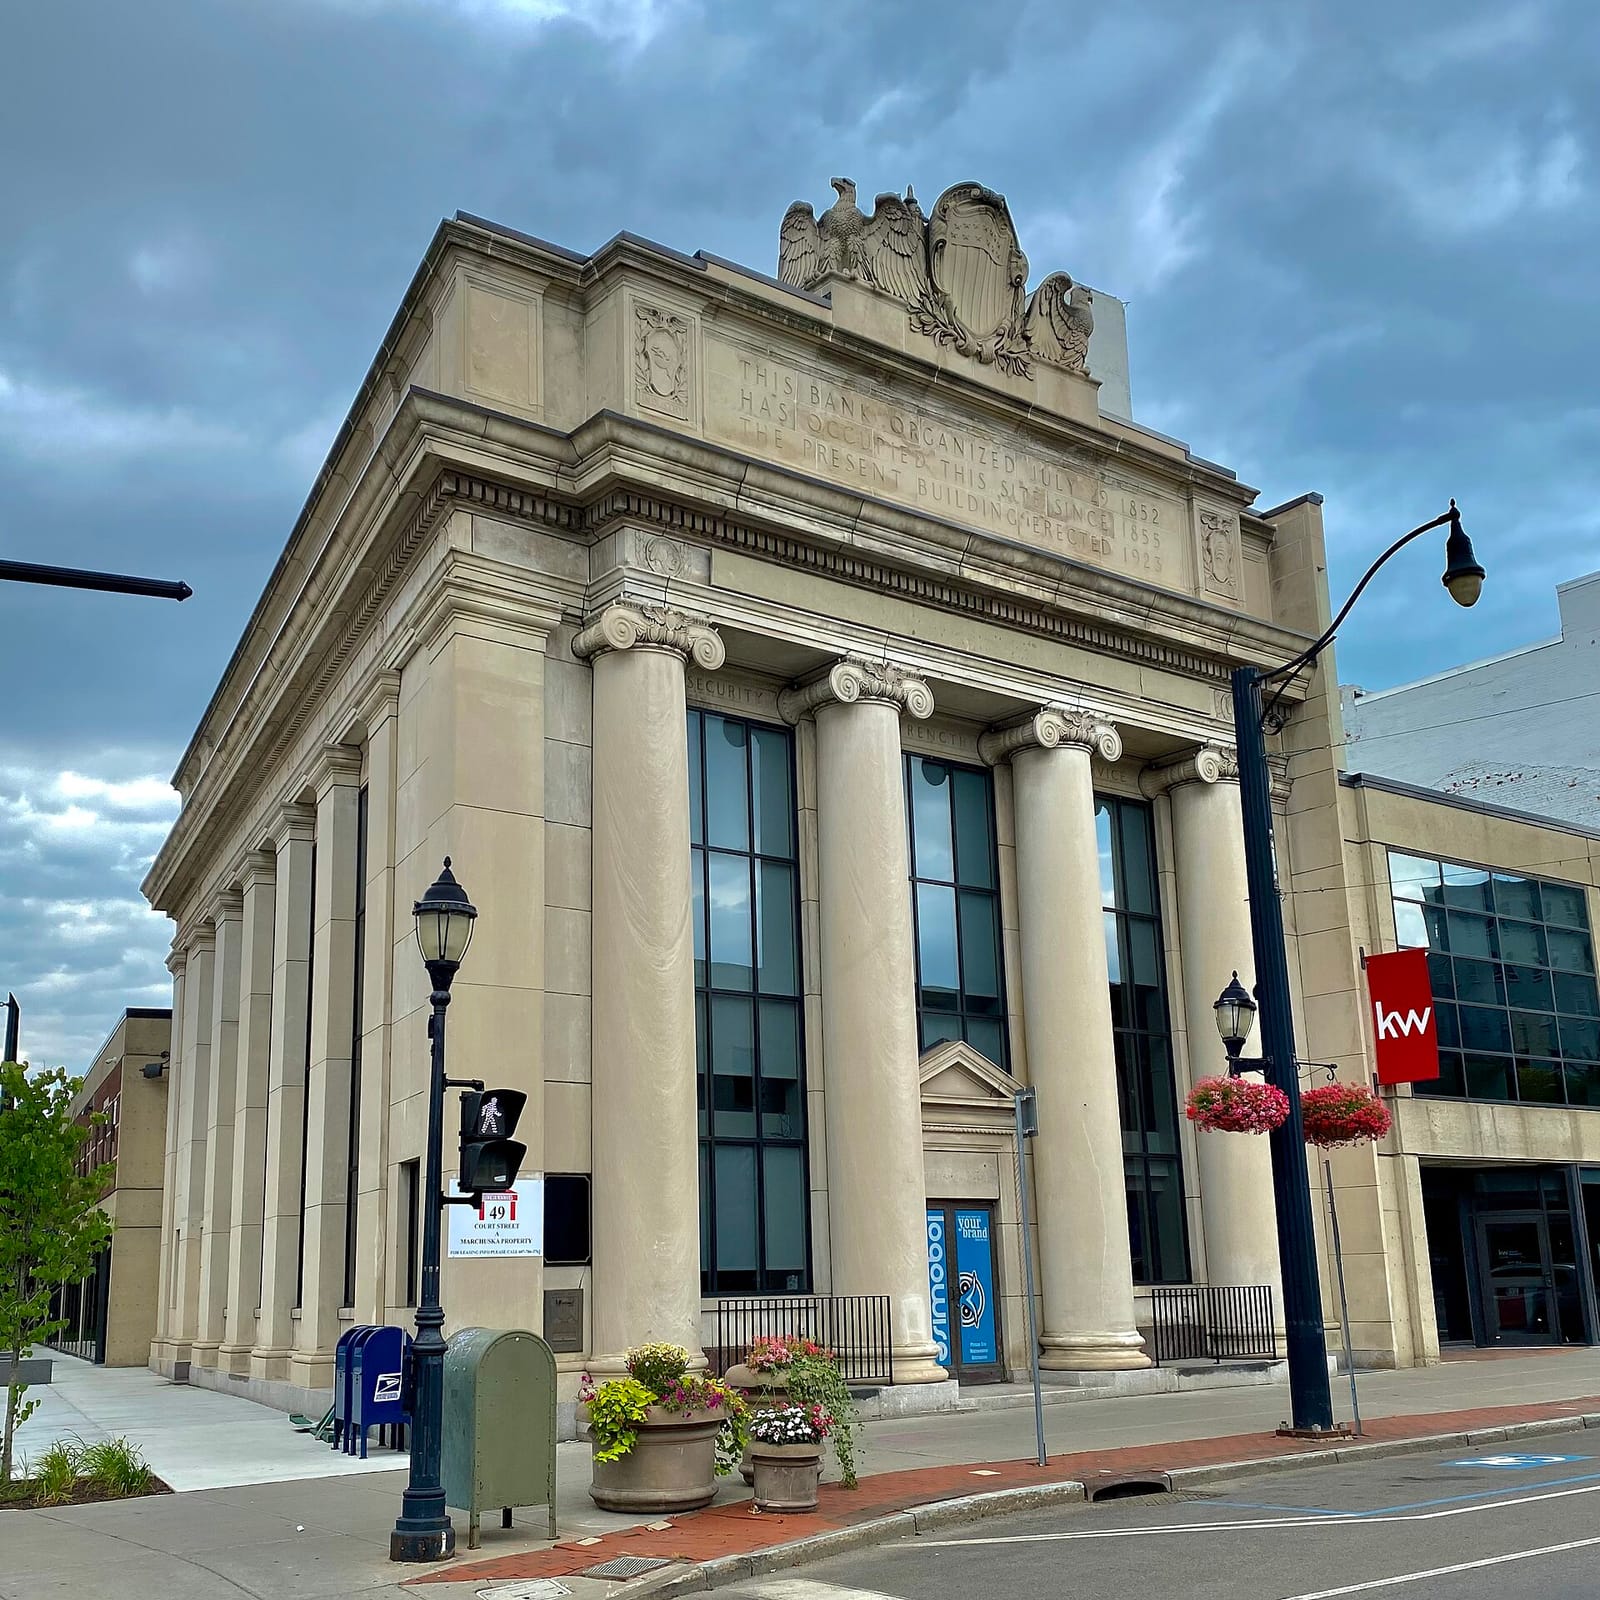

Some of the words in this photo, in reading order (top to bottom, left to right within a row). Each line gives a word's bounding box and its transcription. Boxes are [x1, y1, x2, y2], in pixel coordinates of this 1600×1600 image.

[739, 359, 793, 395] THIS
[810, 385, 872, 424] BANK
[889, 415, 1015, 473] ORGANIZED
[1030, 464, 1074, 496] JULY
[1121, 497, 1160, 525] 1852
[740, 388, 788, 423] HAS
[807, 413, 926, 469] OCCUPIED
[940, 459, 986, 490] THIS
[1000, 479, 1042, 505] SITE
[1054, 498, 1110, 532] SINCE
[1122, 520, 1161, 549] 1855
[739, 416, 784, 449] THE
[803, 438, 902, 489] PRESENT
[918, 477, 1017, 525] BUILDING
[1032, 515, 1112, 556] ERECTED
[1123, 546, 1162, 573] 1923
[687, 676, 764, 705] SECURITY
[1375, 1001, 1432, 1040] kw
[489, 1205, 506, 1220] 49
[957, 1218, 982, 1232] your
[962, 1226, 988, 1239] brand
